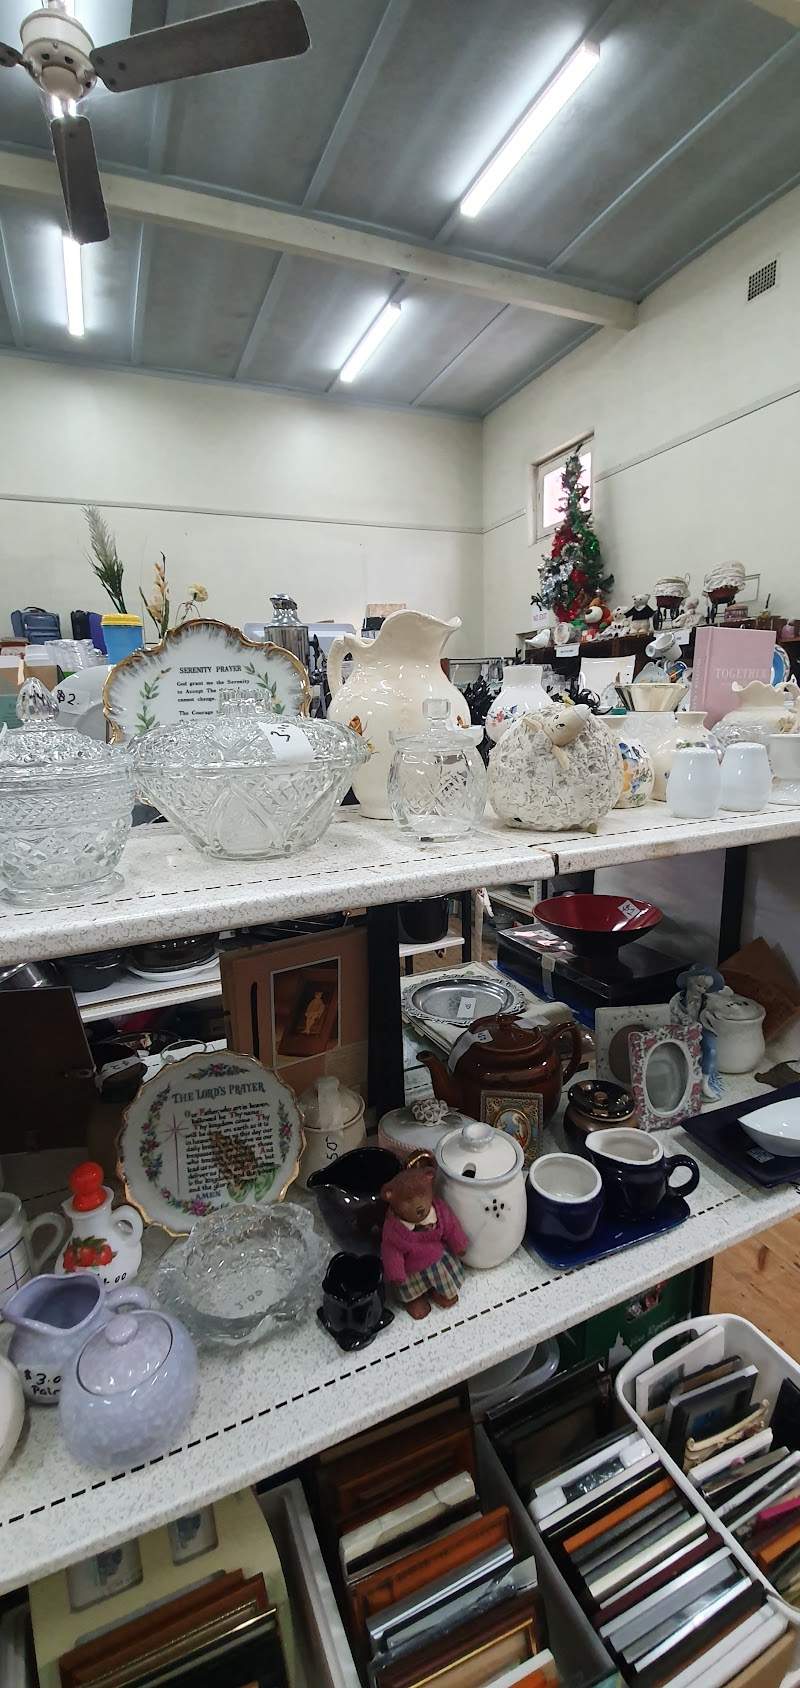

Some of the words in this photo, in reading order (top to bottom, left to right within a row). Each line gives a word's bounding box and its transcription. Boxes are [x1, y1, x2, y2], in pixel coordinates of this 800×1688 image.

[179, 666, 212, 674] SERENITY
[216, 665, 242, 673] PRAYER
[172, 1091, 194, 1104] THE
[195, 1086, 227, 1100] LORD'S
[229, 1081, 266, 1095] PRAYER
[256, 1113, 270, 1121] Thy
[251, 1128, 262, 1136] day
[196, 1191, 221, 1200] AMEN
